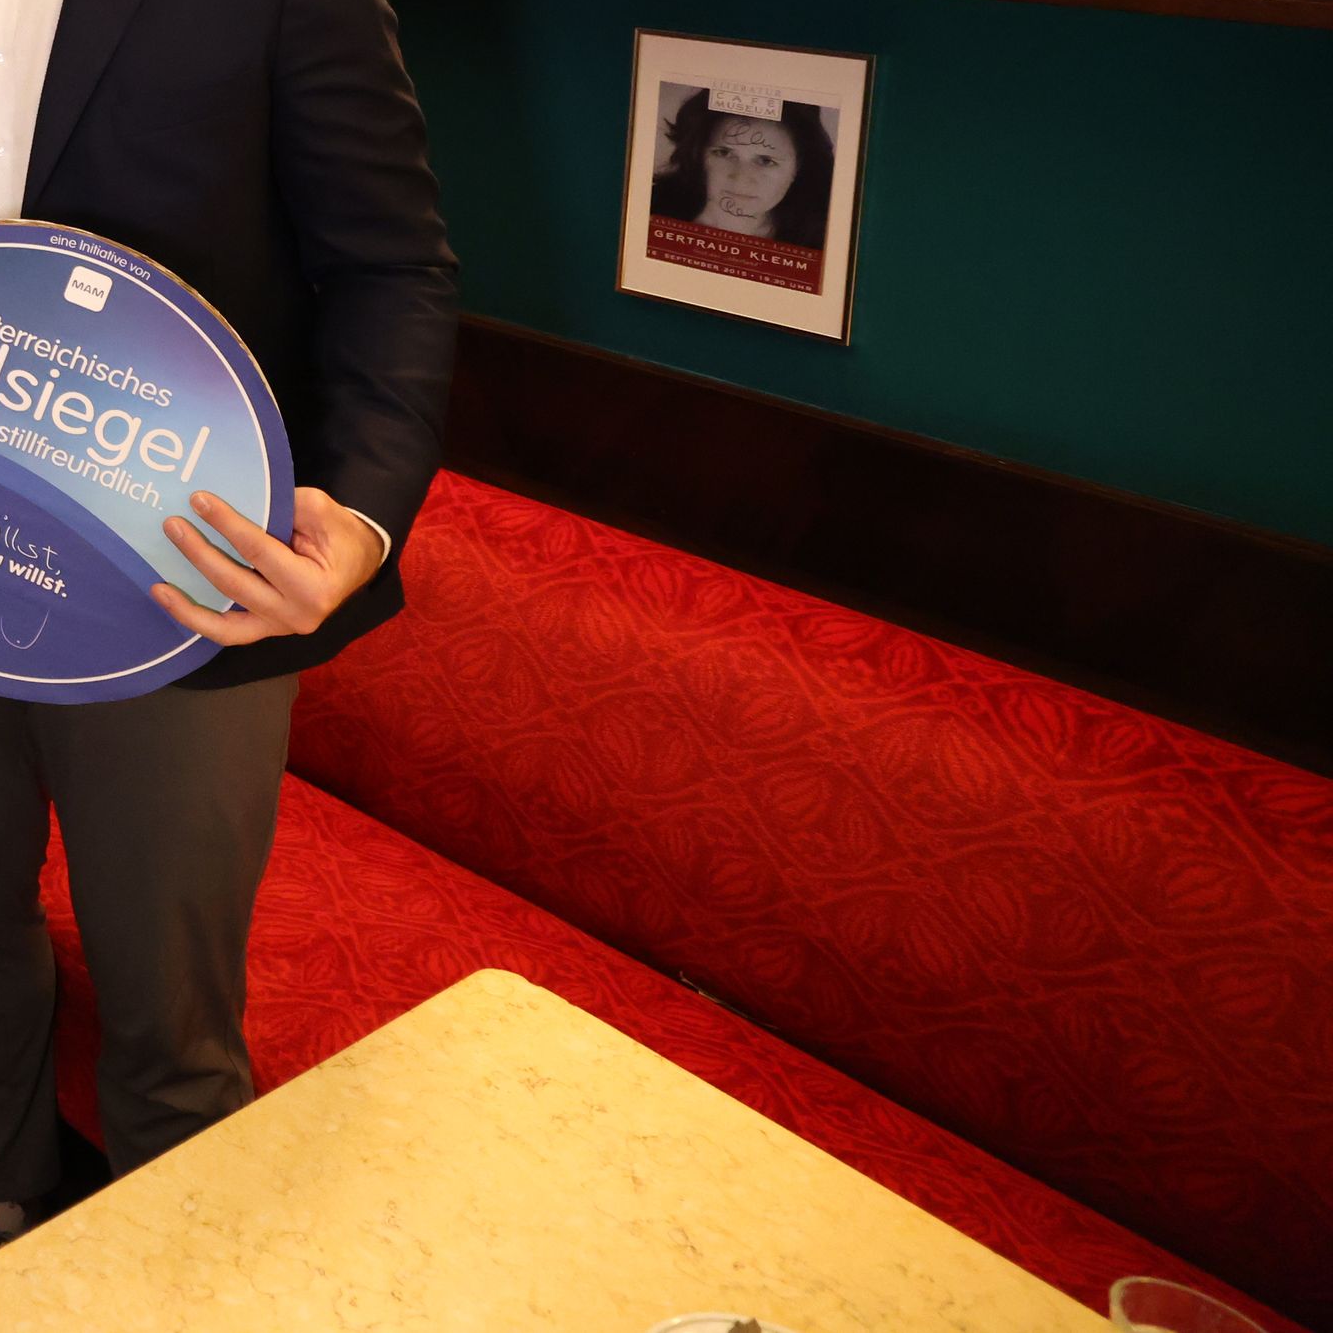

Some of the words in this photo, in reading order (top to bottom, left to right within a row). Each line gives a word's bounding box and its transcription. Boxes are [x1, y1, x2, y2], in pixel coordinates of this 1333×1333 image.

[49, 234, 77, 250] eine
[78, 239, 128, 267] Initiative
[129, 260, 152, 281] von
[654, 229, 740, 255] GERTRAUD
[750, 250, 808, 271] KLEMM
[70, 279, 106, 302] MAM
[8, 555, 69, 599] willst.
